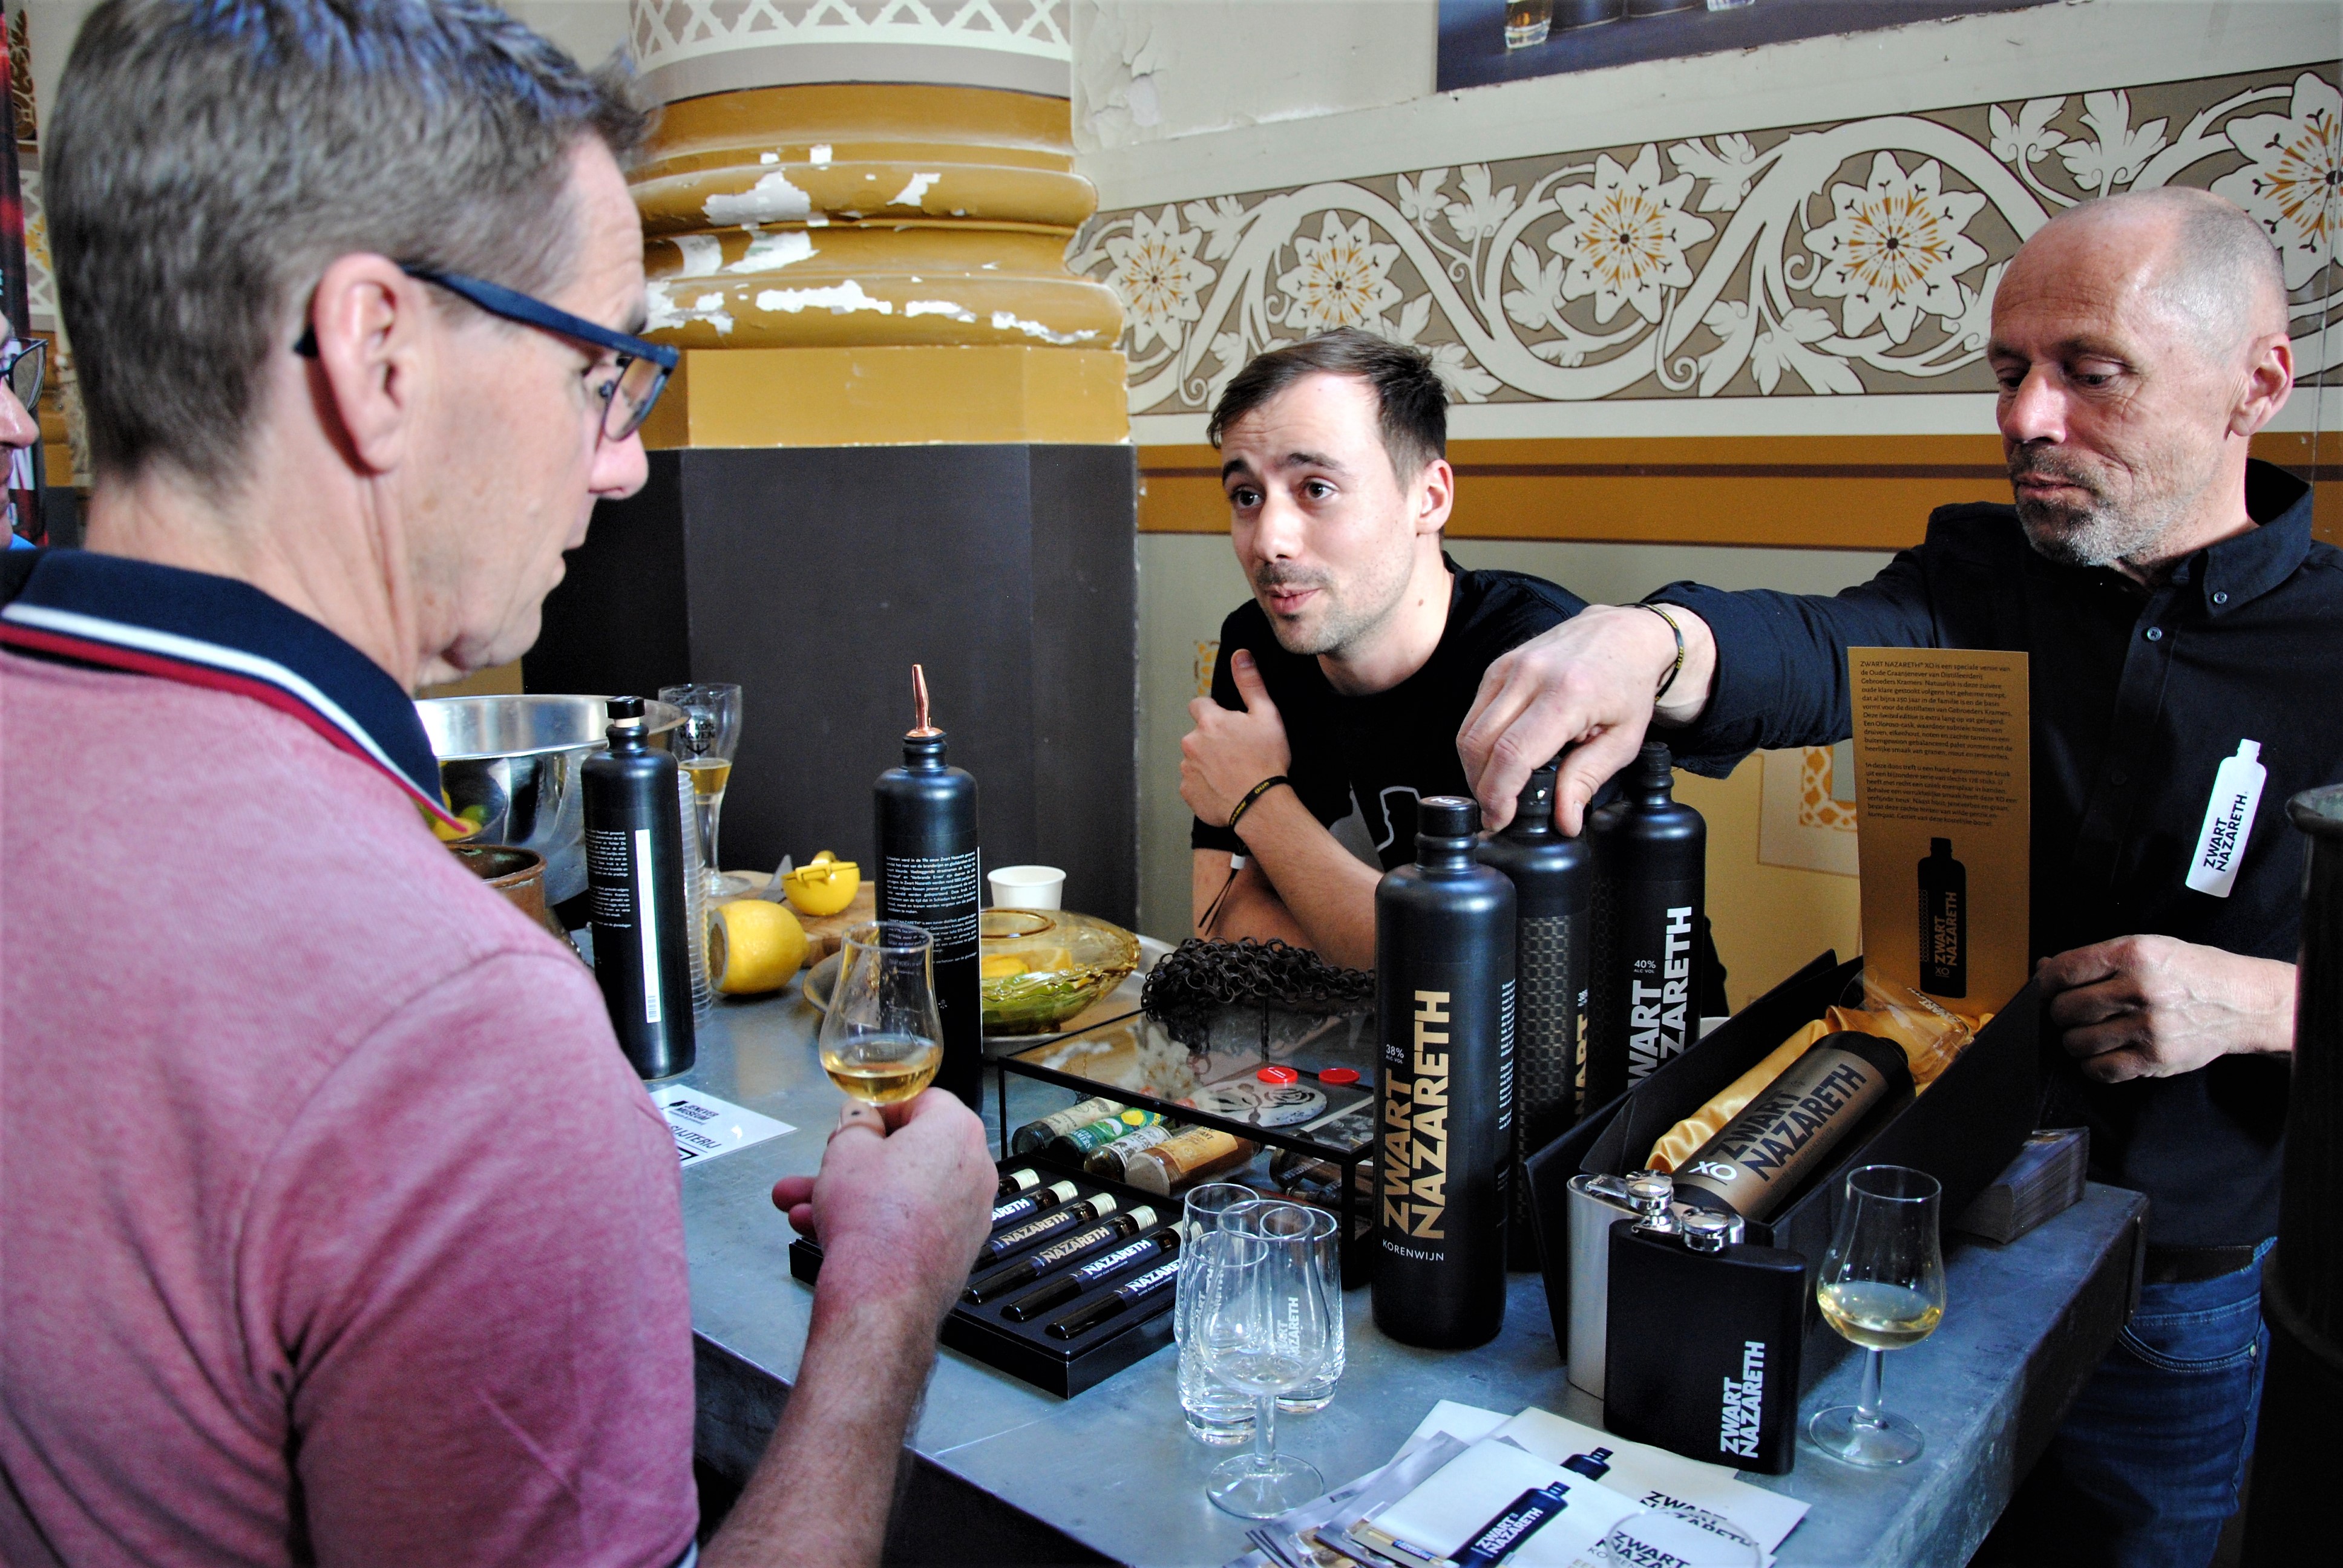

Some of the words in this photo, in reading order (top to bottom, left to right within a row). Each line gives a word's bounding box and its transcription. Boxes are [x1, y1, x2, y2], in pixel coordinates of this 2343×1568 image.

[2203, 817, 2227, 869] ZWART
[2215, 794, 2247, 872] NAZARETH
[1935, 915, 1946, 964] ZWART
[1945, 892, 1957, 966] NAZARETH
[1634, 959, 1656, 969] 40%
[1936, 967, 1950, 976] XO
[1386, 1044, 1404, 1059] 38%
[1411, 990, 1450, 1239] NAZARETH
[1709, 1091, 1801, 1161] ZWART
[1740, 1063, 1867, 1182] NAZARETH
[1383, 1068, 1411, 1236] ZWART
[1688, 1160, 1737, 1180] XO
[999, 1211, 1069, 1246] NAZARETH
[1041, 1227, 1110, 1263] NAZARETH
[1383, 1239, 1444, 1261] KORENWIJN
[1081, 1239, 1152, 1275] NAZARETH
[1720, 1376, 1743, 1455] ZWART
[1739, 1341, 1765, 1459] NAZARETH
[1476, 1515, 1515, 1550] ZWART
[1487, 1508, 1544, 1553] NAZARETH
[1614, 1530, 1691, 1568] ZWART
